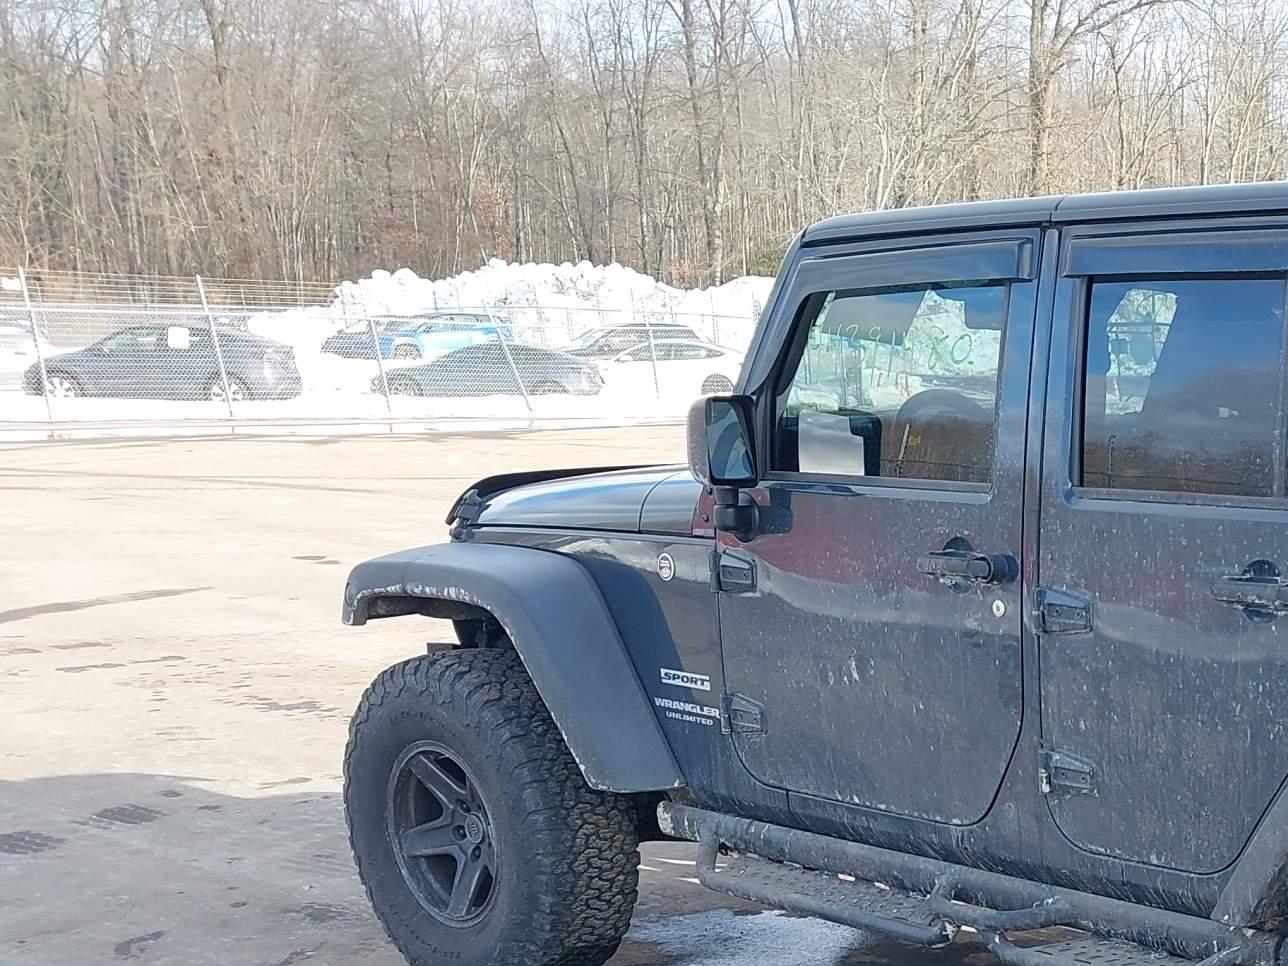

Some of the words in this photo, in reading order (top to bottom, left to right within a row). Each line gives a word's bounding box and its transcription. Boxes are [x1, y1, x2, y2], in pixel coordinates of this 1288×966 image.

[663, 672, 708, 686] SPORT
[654, 697, 721, 719] WRANGLER
[666, 711, 714, 726] UNLIMITED
